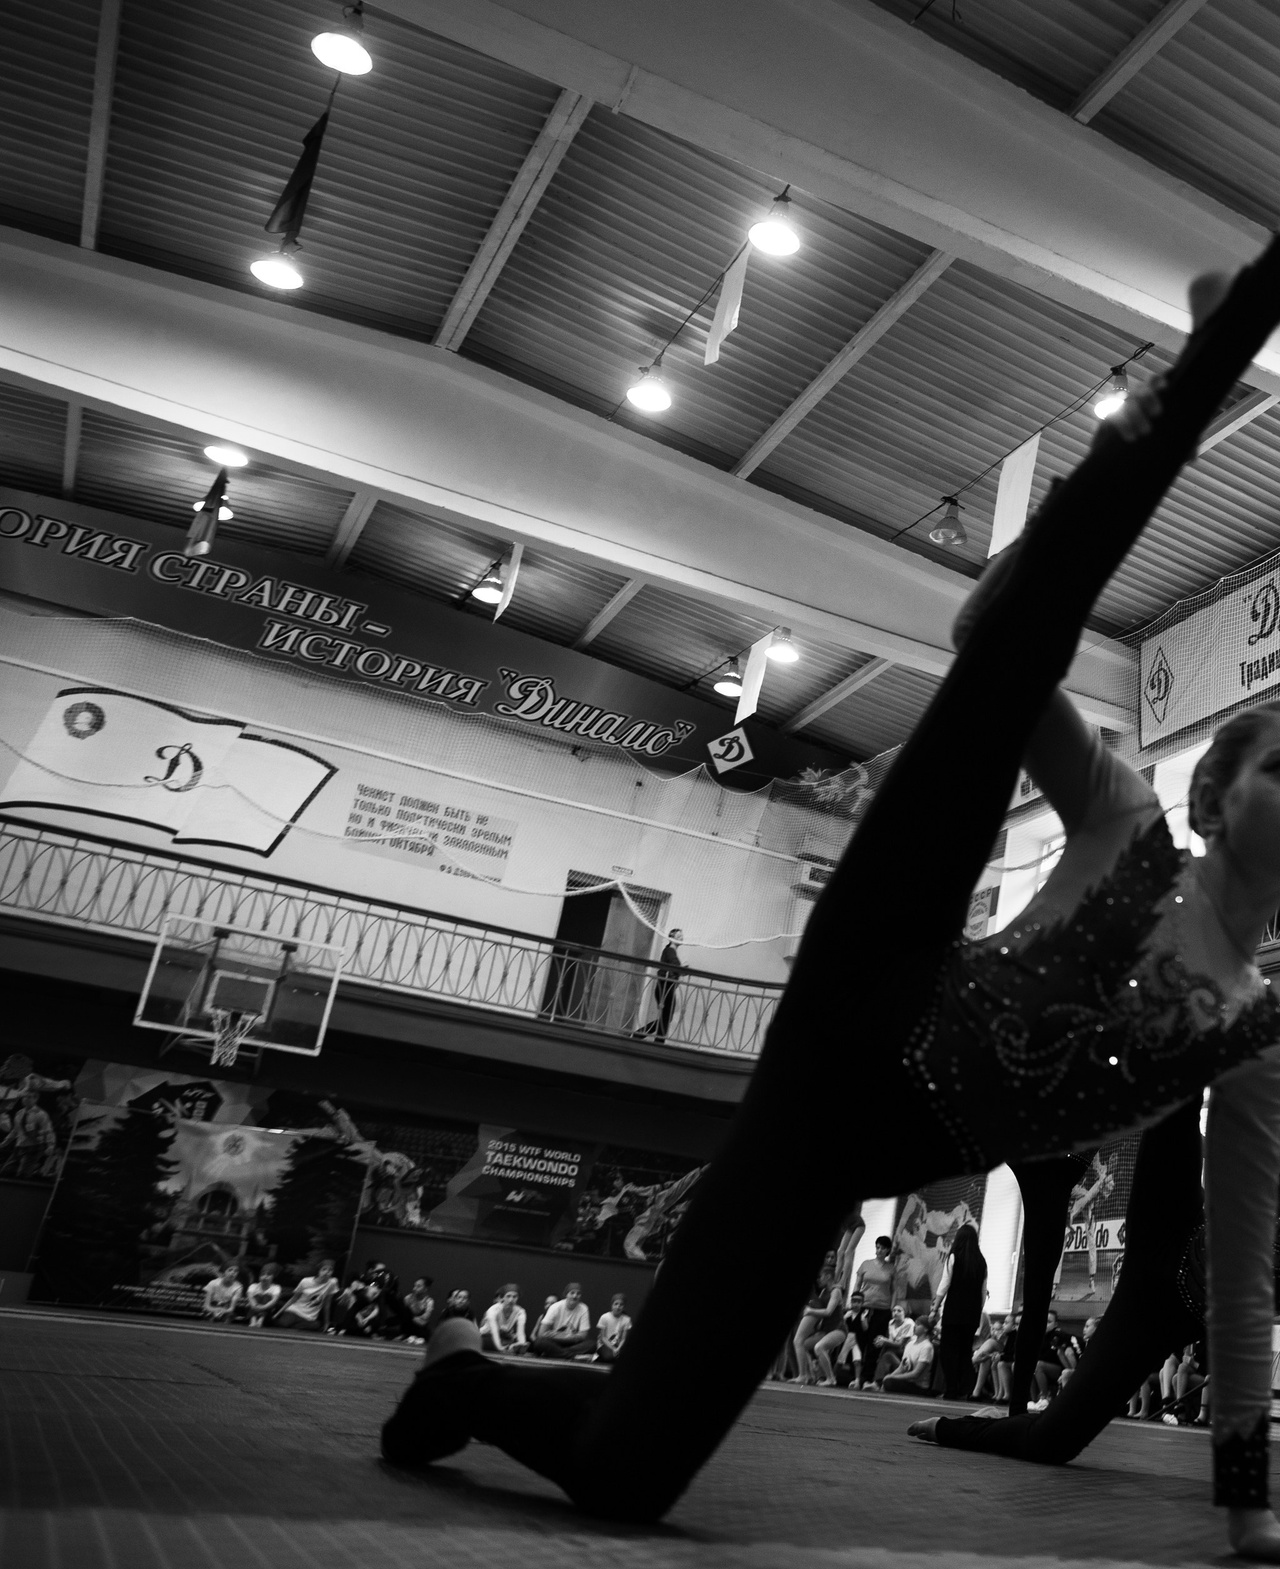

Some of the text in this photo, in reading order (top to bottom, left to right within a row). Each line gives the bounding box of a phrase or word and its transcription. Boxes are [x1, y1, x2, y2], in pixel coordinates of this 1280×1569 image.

[149, 550, 374, 636] СТРАНЫ
[257, 618, 488, 706] ИСТОРИЯ
[485, 1150, 579, 1176] TAEKWONDO
[487, 1140, 581, 1163] 2015 WTF WORLD
[482, 1165, 576, 1188] CHAMPIONSHIPS
[1075, 1223, 1109, 1250] Dado
